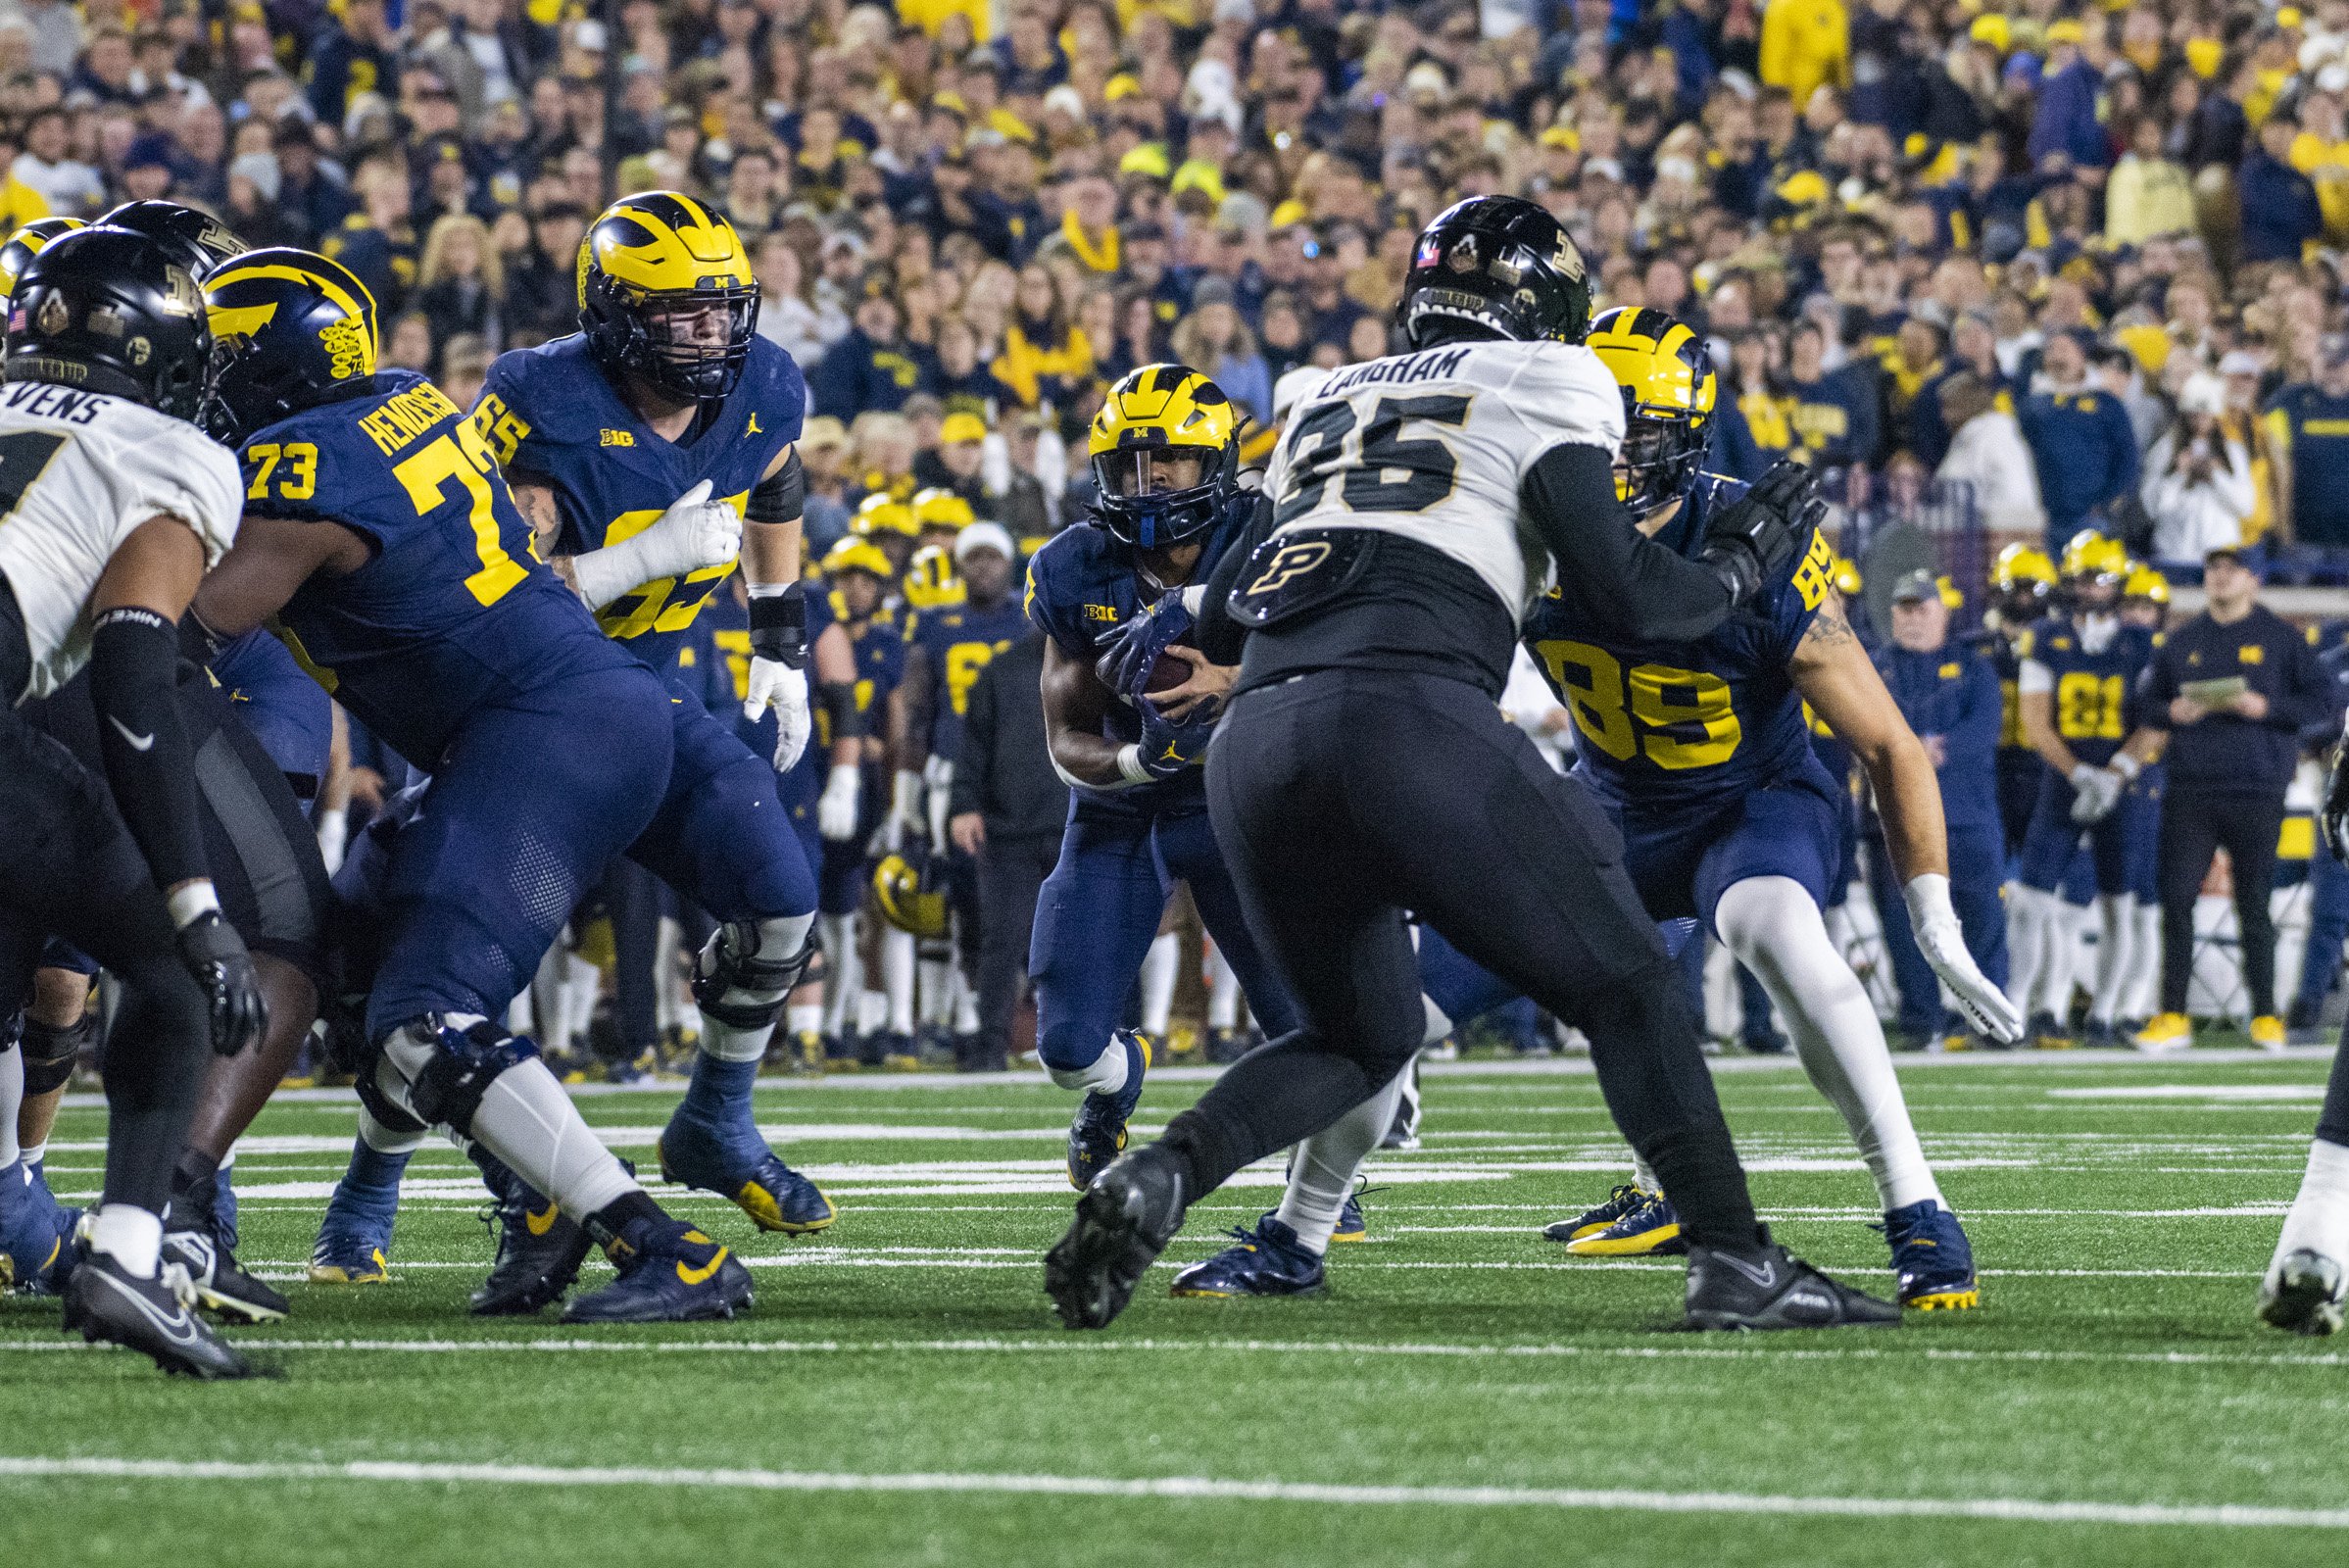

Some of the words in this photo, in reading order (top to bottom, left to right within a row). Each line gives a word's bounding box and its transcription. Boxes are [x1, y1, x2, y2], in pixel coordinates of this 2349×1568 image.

[714, 276, 729, 289] M
[352, 358, 364, 372] 73
[1317, 348, 1472, 399] LANGHAM
[6, 379, 111, 425] VENS
[1134, 426, 1149, 438] M
[247, 442, 318, 501] 73
[1247, 541, 1333, 597] P
[1791, 526, 1835, 612] 89
[1536, 639, 1742, 770] 89
